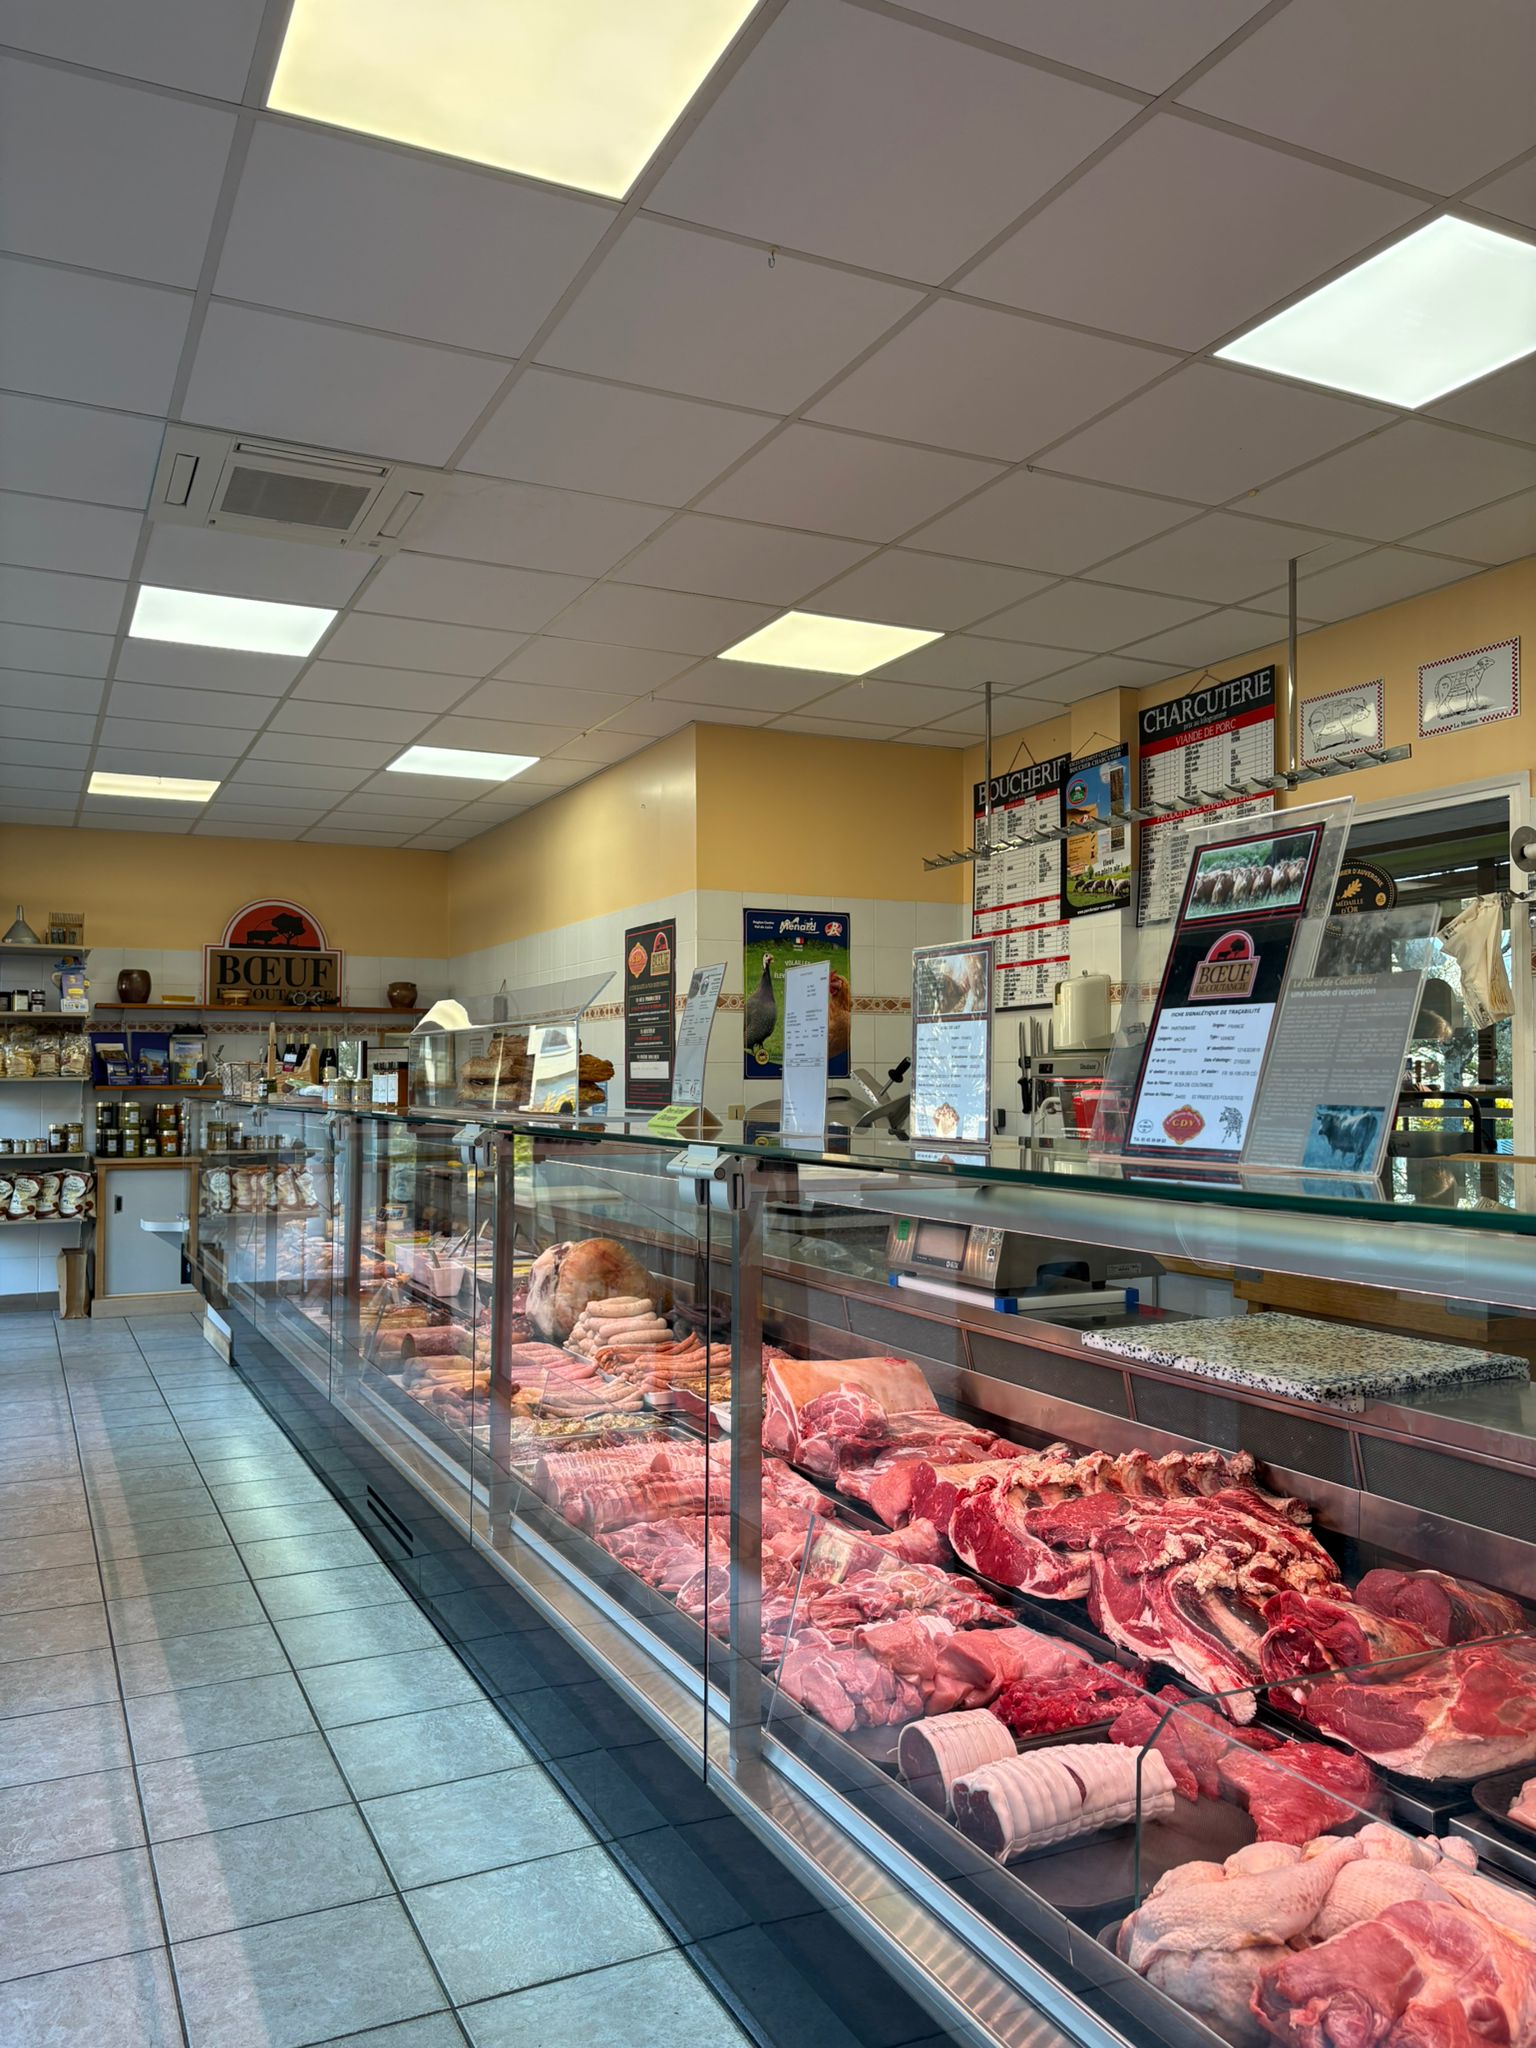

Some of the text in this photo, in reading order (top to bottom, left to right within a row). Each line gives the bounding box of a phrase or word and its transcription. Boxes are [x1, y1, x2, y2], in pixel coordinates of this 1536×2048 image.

[1143, 670, 1272, 733] CHARCUTERIE
[1175, 718, 1237, 746] VIANDE DE PORC
[216, 955, 333, 987] BŒUF
[1199, 963, 1253, 984] BŒUF
[1205, 981, 1248, 993] COUTANCIE
[1323, 977, 1334, 986] de
[1290, 990, 1304, 999] une
[1309, 989, 1331, 998] viande
[1228, 1007, 1261, 1016] TRAÇABILITÉ
